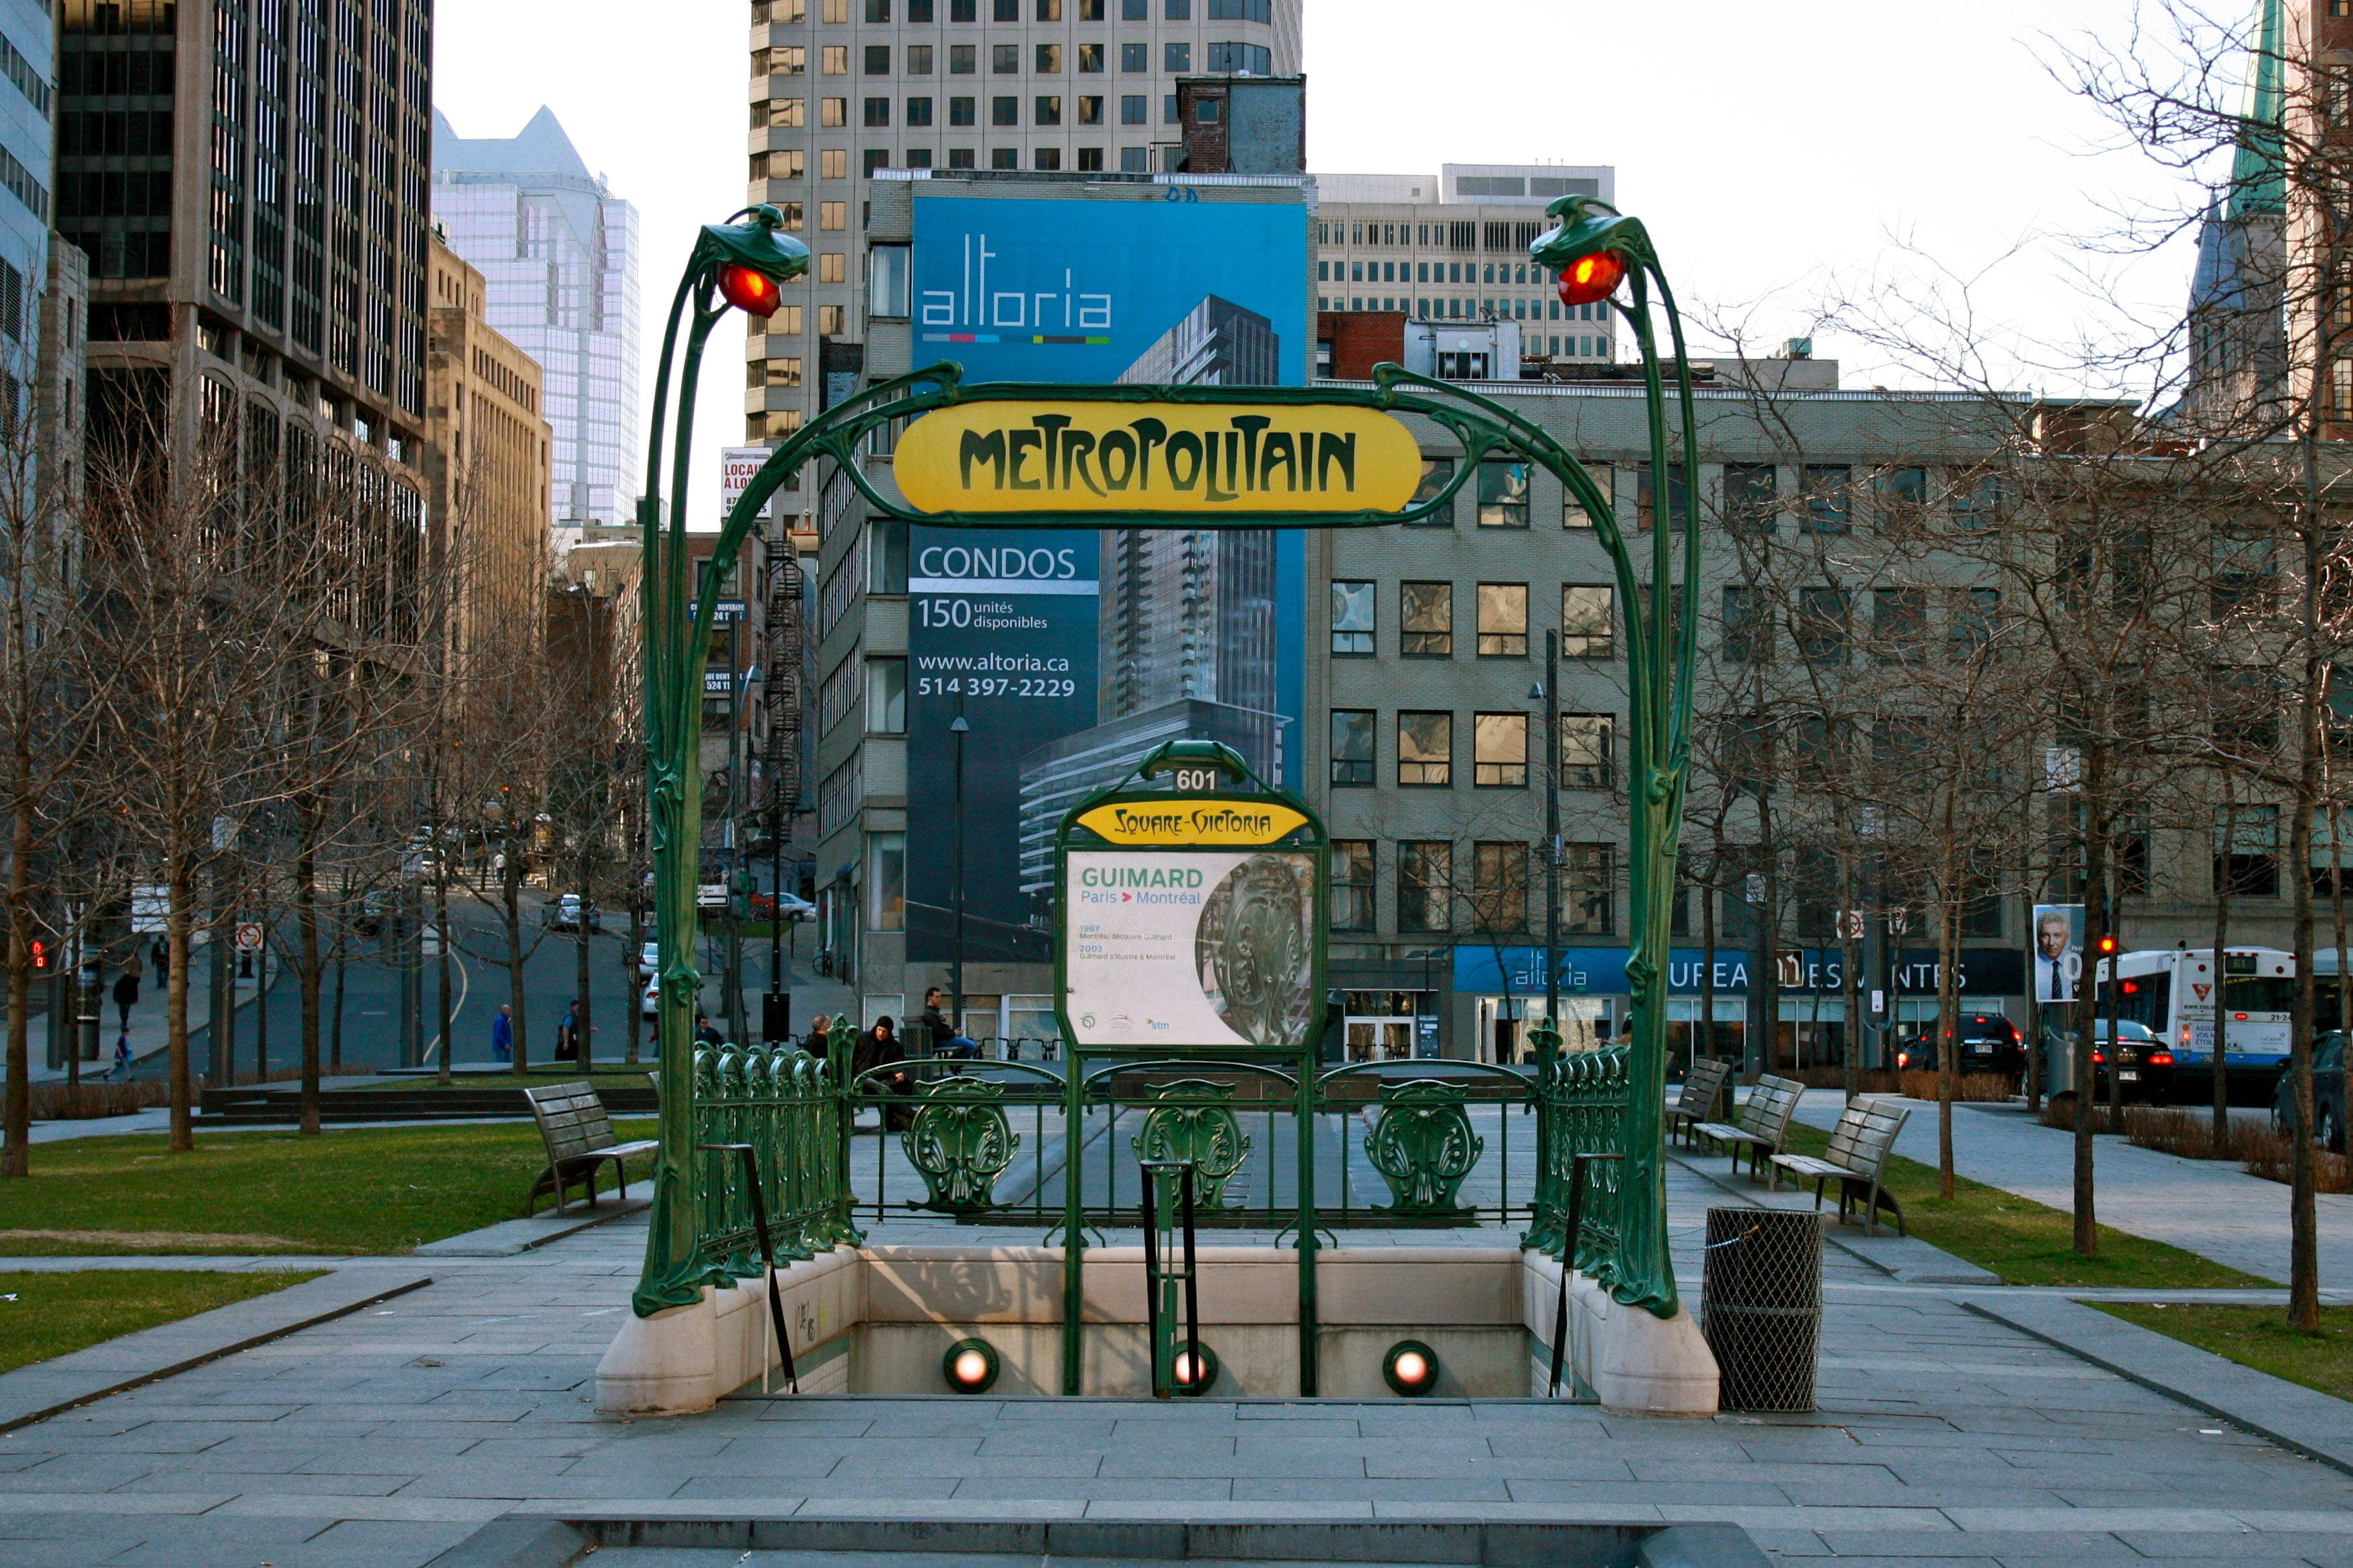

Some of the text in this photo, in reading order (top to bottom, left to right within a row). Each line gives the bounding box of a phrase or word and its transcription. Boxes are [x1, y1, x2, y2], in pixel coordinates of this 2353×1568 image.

[923, 234, 1111, 328] altoria
[959, 414, 1356, 502] METROPOLITAIN
[919, 547, 1075, 579] CONDOS
[919, 599, 1013, 627] 150 unités
[974, 616, 1047, 631] disponibles
[919, 652, 1069, 671] www.altoria.ca
[919, 678, 1075, 697] 514 397-2229
[1177, 769, 1216, 790] 601
[1081, 867, 1203, 888] GUIMARD
[1081, 891, 1201, 904] Paris Montréal
[1151, 1021, 1169, 1029] stm
